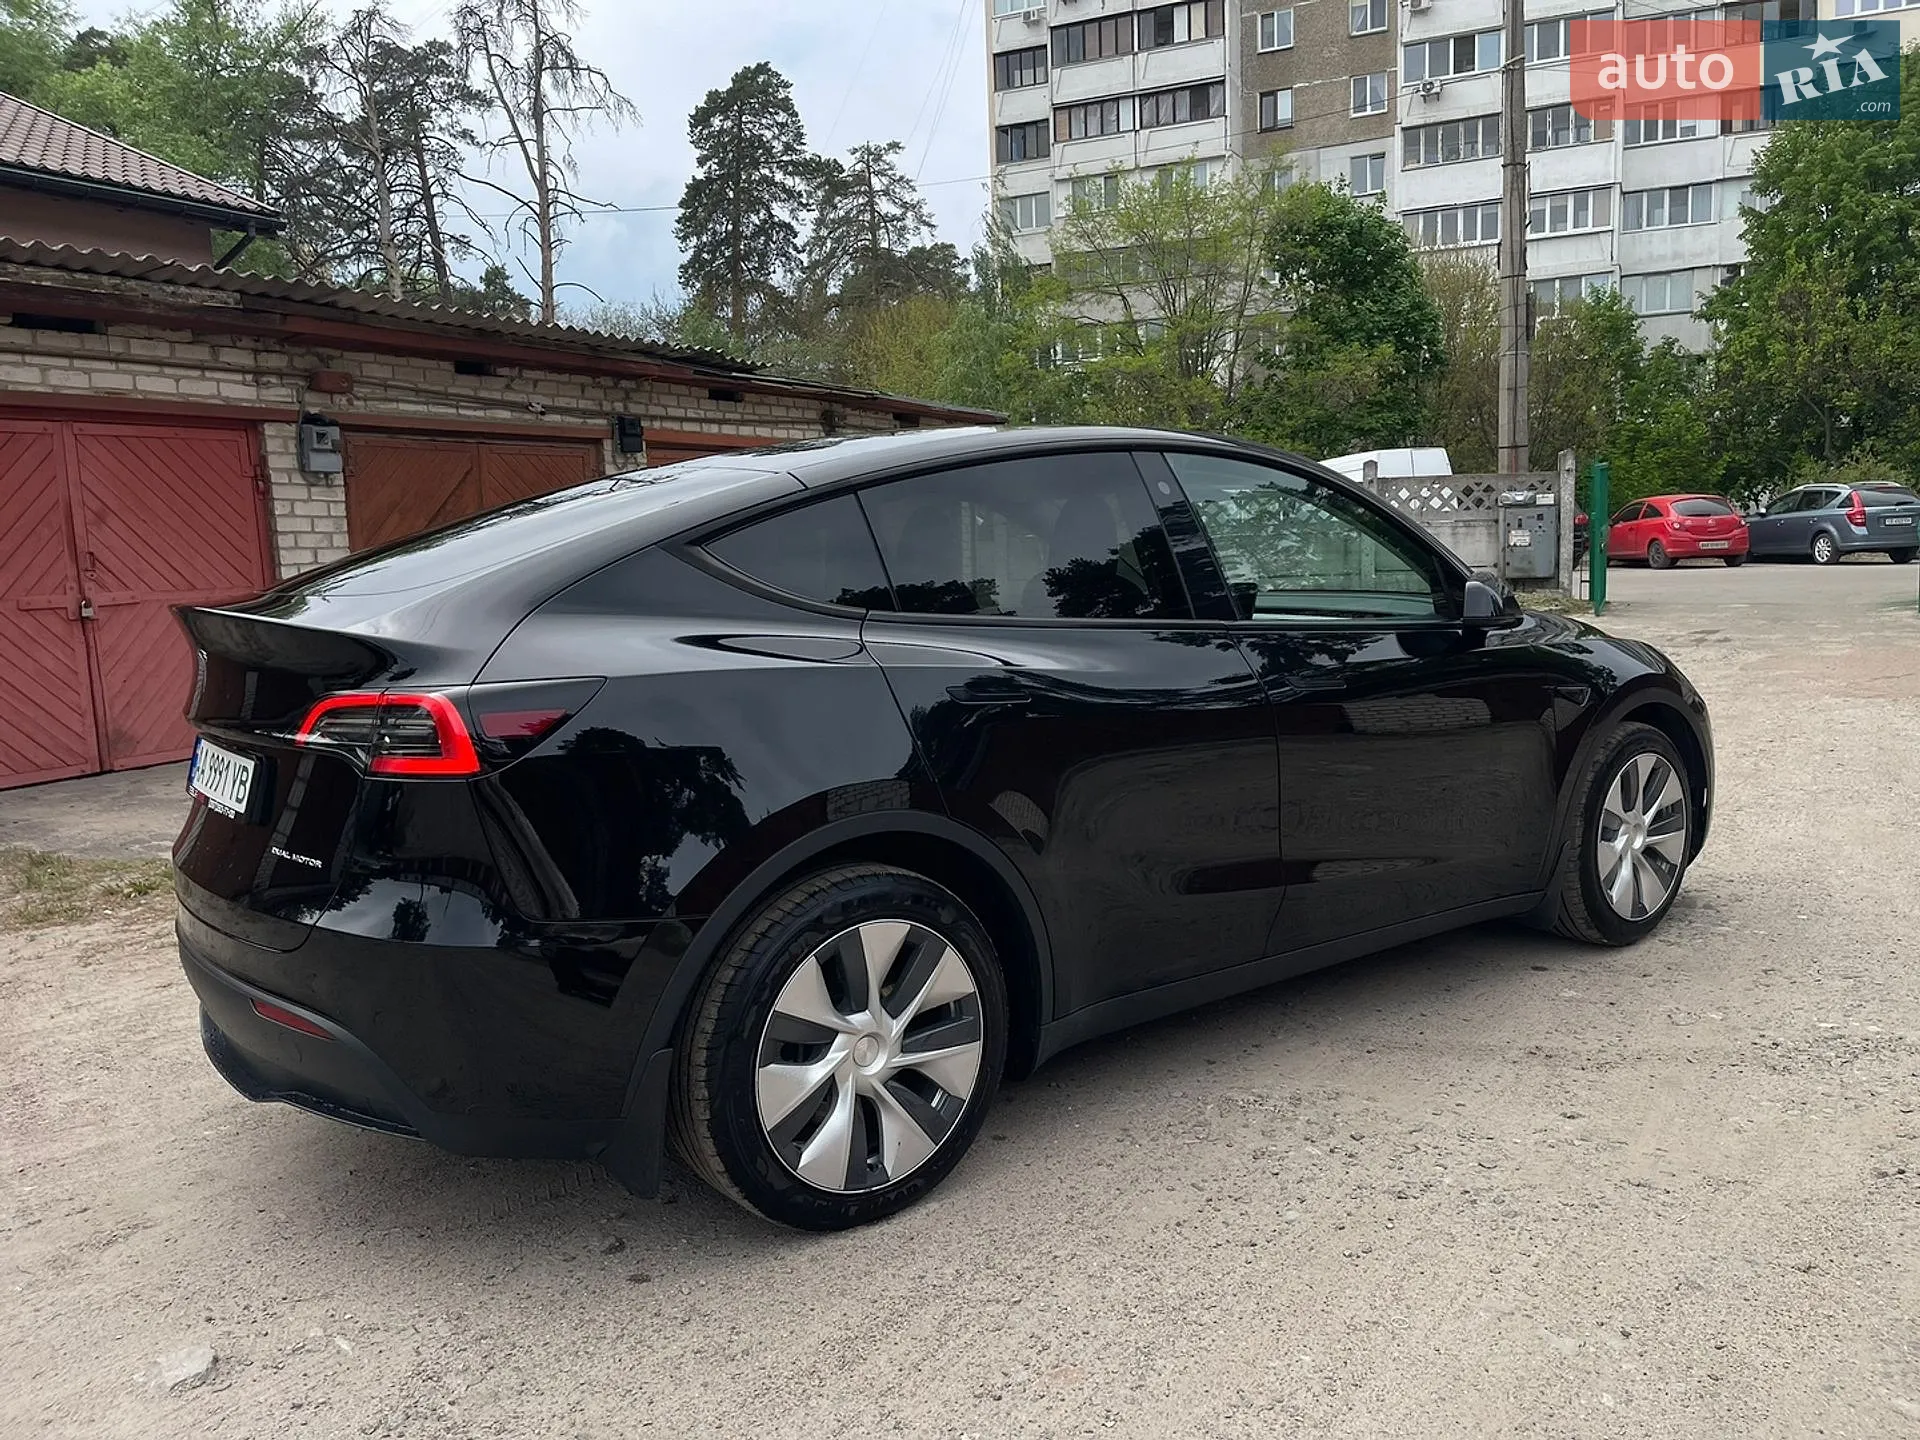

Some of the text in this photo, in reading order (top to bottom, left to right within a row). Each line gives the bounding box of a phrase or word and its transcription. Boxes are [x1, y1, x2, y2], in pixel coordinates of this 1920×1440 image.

[229, 761, 250, 805] YB
[271, 846, 322, 869] DUAL MOTOR
